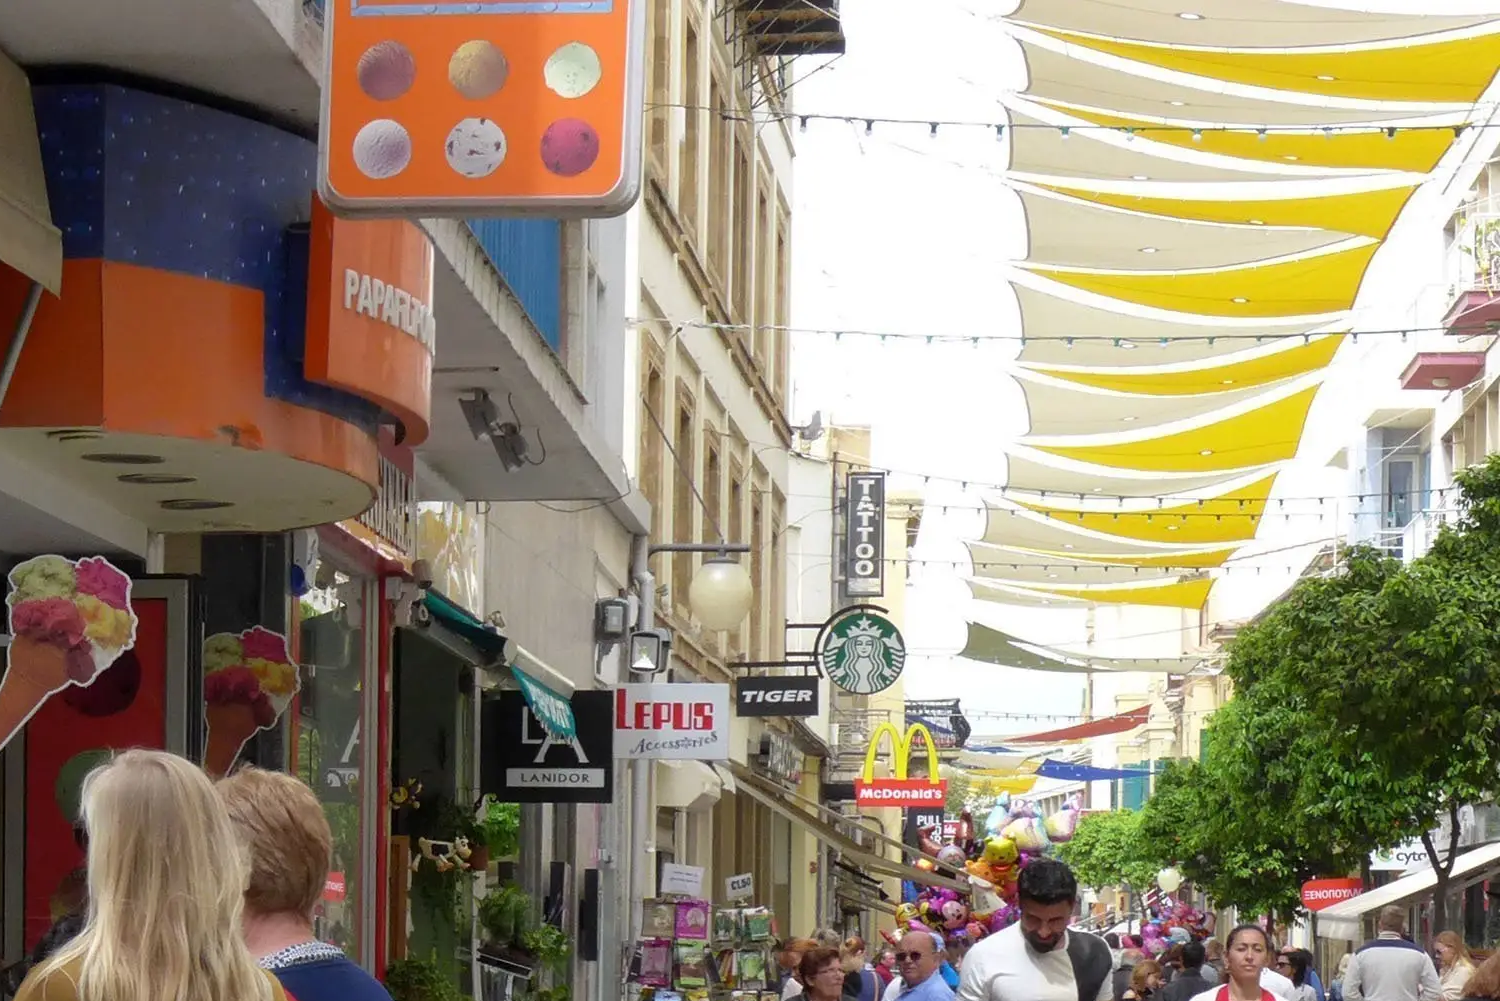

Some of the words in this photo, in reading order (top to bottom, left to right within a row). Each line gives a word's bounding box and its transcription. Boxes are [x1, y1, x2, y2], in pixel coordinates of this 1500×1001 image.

[855, 479, 876, 576] TATTOO
[742, 689, 813, 702] TIGER
[616, 688, 713, 730] LEPUS
[521, 773, 590, 783] LANIDOR
[860, 788, 942, 799] McDonald's
[917, 815, 942, 826] PULL
[1304, 888, 1364, 901] ΞΕΝΟΠΟΥΛΛ
